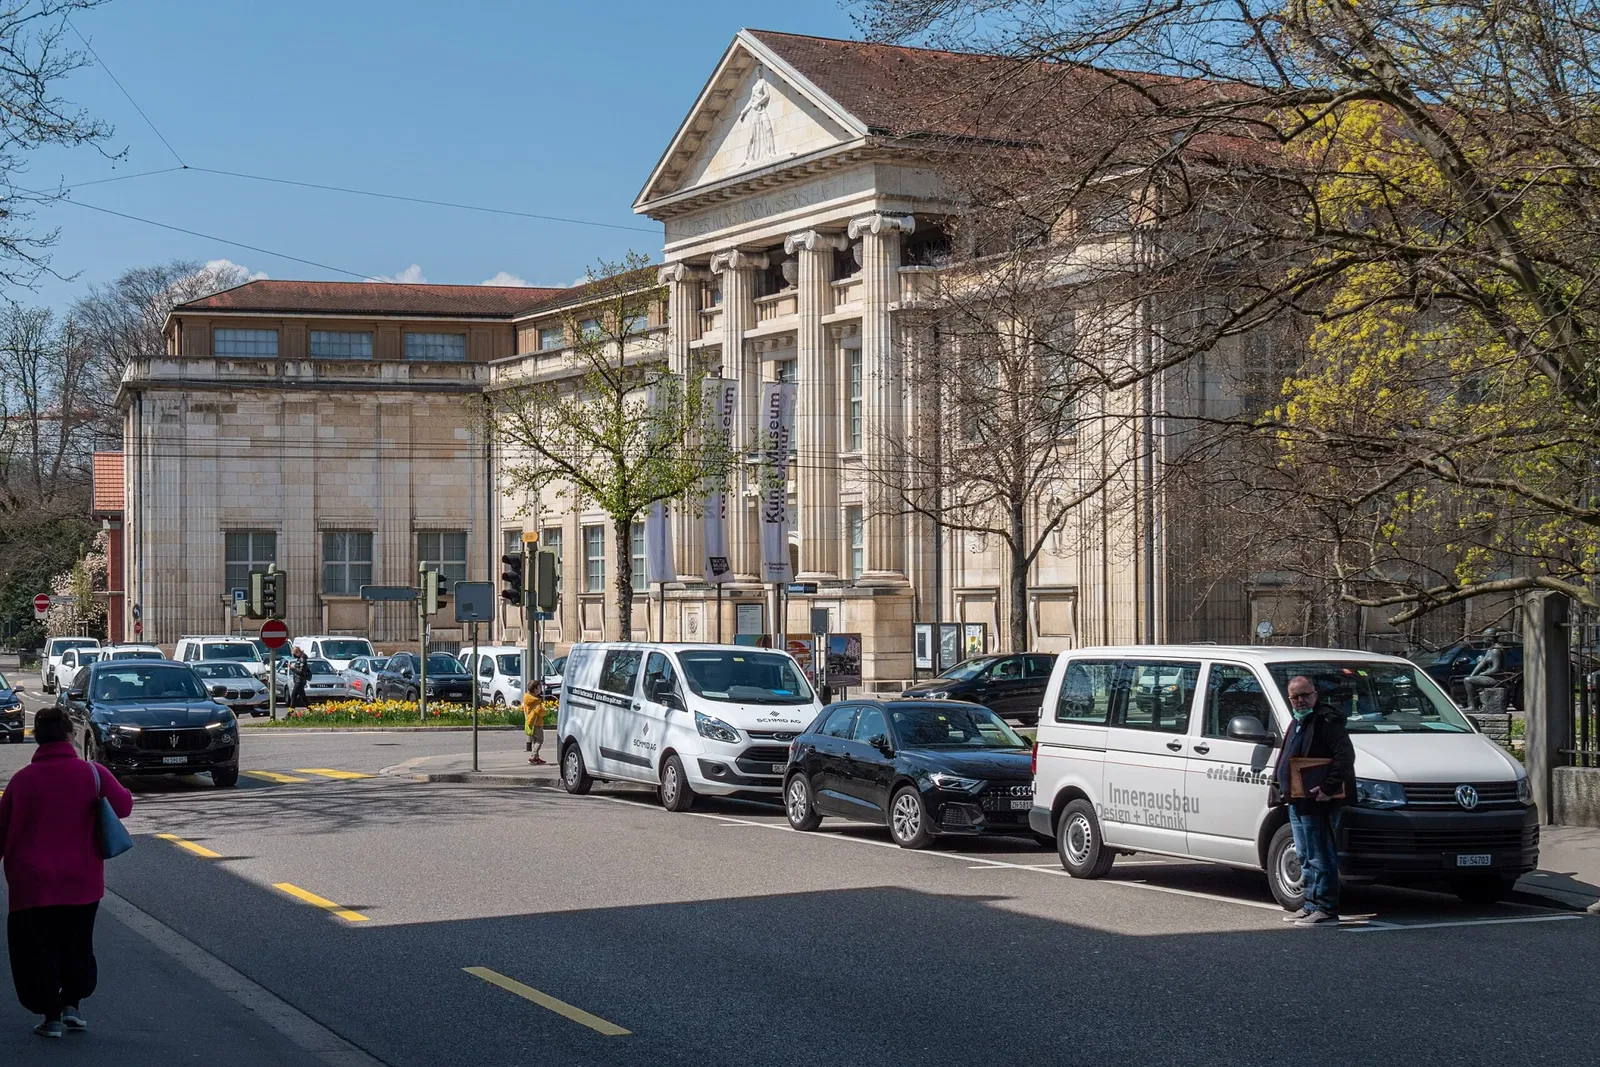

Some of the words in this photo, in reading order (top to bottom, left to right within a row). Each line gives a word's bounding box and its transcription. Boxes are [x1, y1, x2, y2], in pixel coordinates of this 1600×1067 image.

[722, 386, 735, 462] useum
[766, 393, 780, 467] Museum
[766, 474, 780, 523] Kunst
[633, 738, 650, 750] SCHMID
[1095, 803, 1131, 824] Design
[1142, 808, 1185, 830] Technik
[1109, 782, 1200, 814] Innenausbau
